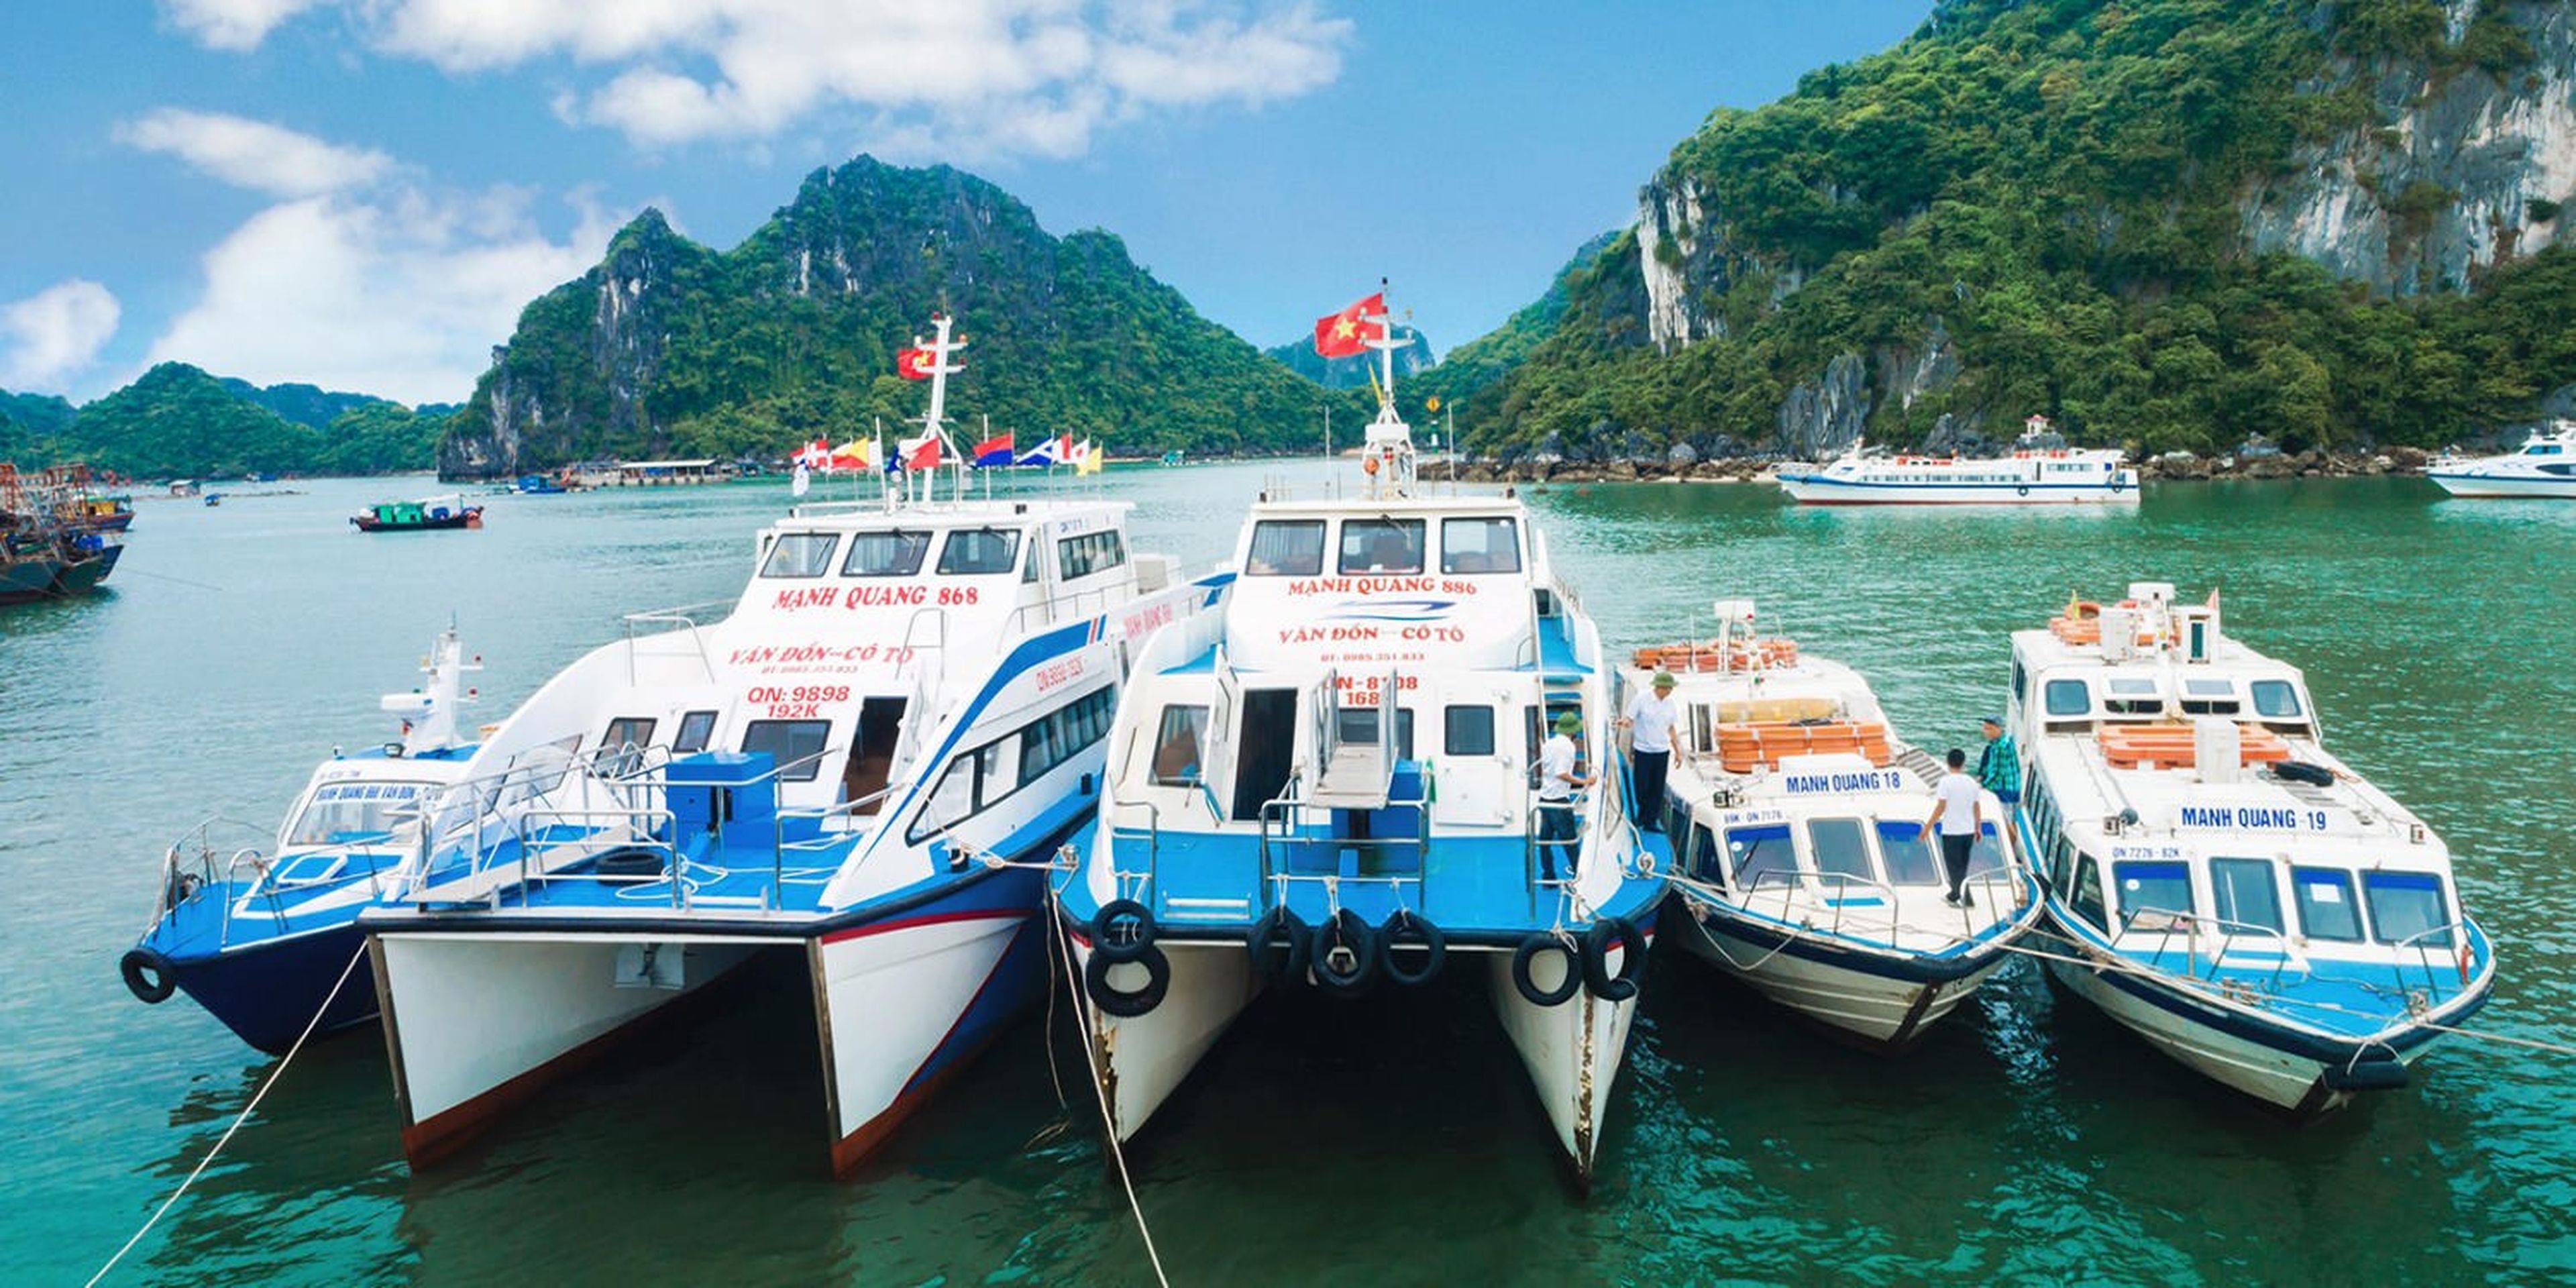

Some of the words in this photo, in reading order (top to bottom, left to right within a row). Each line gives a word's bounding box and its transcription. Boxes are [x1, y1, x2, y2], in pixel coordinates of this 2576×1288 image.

[1357, 578, 1436, 594] QUANG
[1442, 580, 1478, 594] 886
[845, 586, 927, 609] QUANG
[937, 587, 979, 605] 868
[747, 687, 788, 703] QN:
[792, 686, 850, 702] 9898
[767, 704, 820, 718] 192K
[1884, 772, 1900, 789] 18
[2239, 808, 2296, 828] QUANG
[2306, 811, 2326, 830] 19
